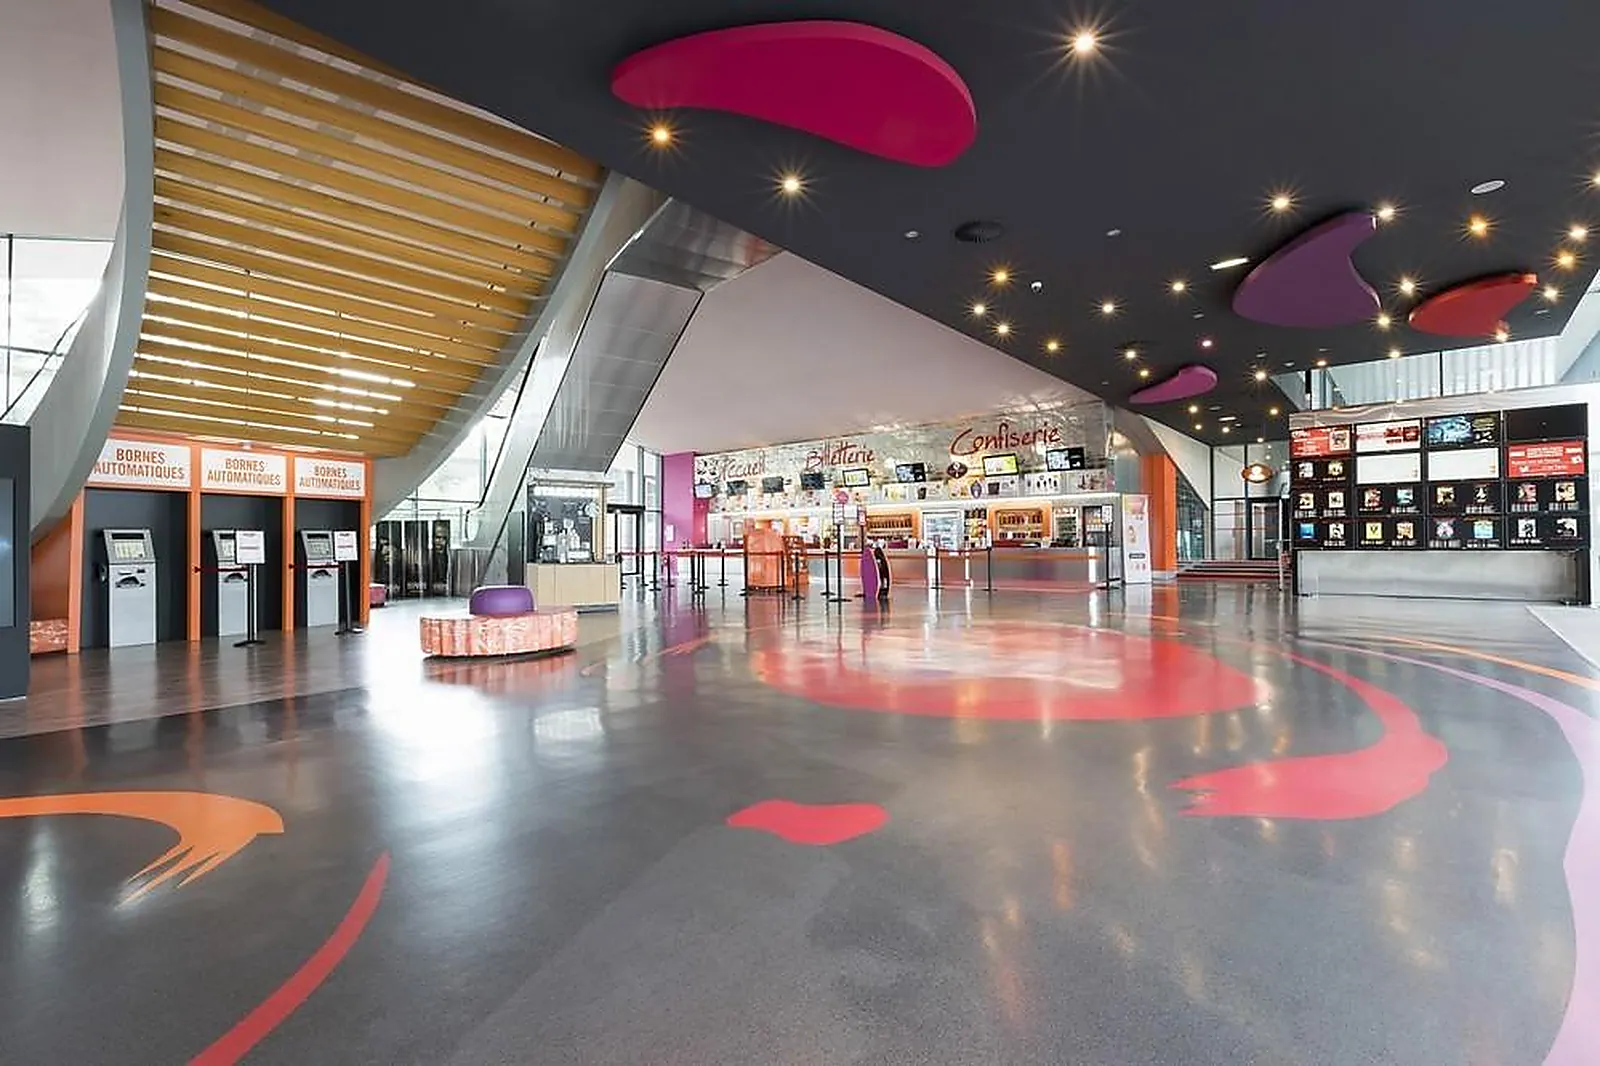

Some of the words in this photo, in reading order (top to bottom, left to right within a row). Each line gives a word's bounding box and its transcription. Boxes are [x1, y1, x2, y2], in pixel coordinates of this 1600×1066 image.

[950, 421, 1062, 456] Confiserie
[116, 448, 165, 464] BORNES
[805, 440, 876, 471] Billetterie
[94, 461, 186, 480] AUTOMATIQUES
[225, 457, 266, 472] BORNES
[314, 465, 348, 478] BORNES
[207, 469, 281, 486] AUTOMATIQUES
[299, 475, 361, 491] AUTOMATIQUES
